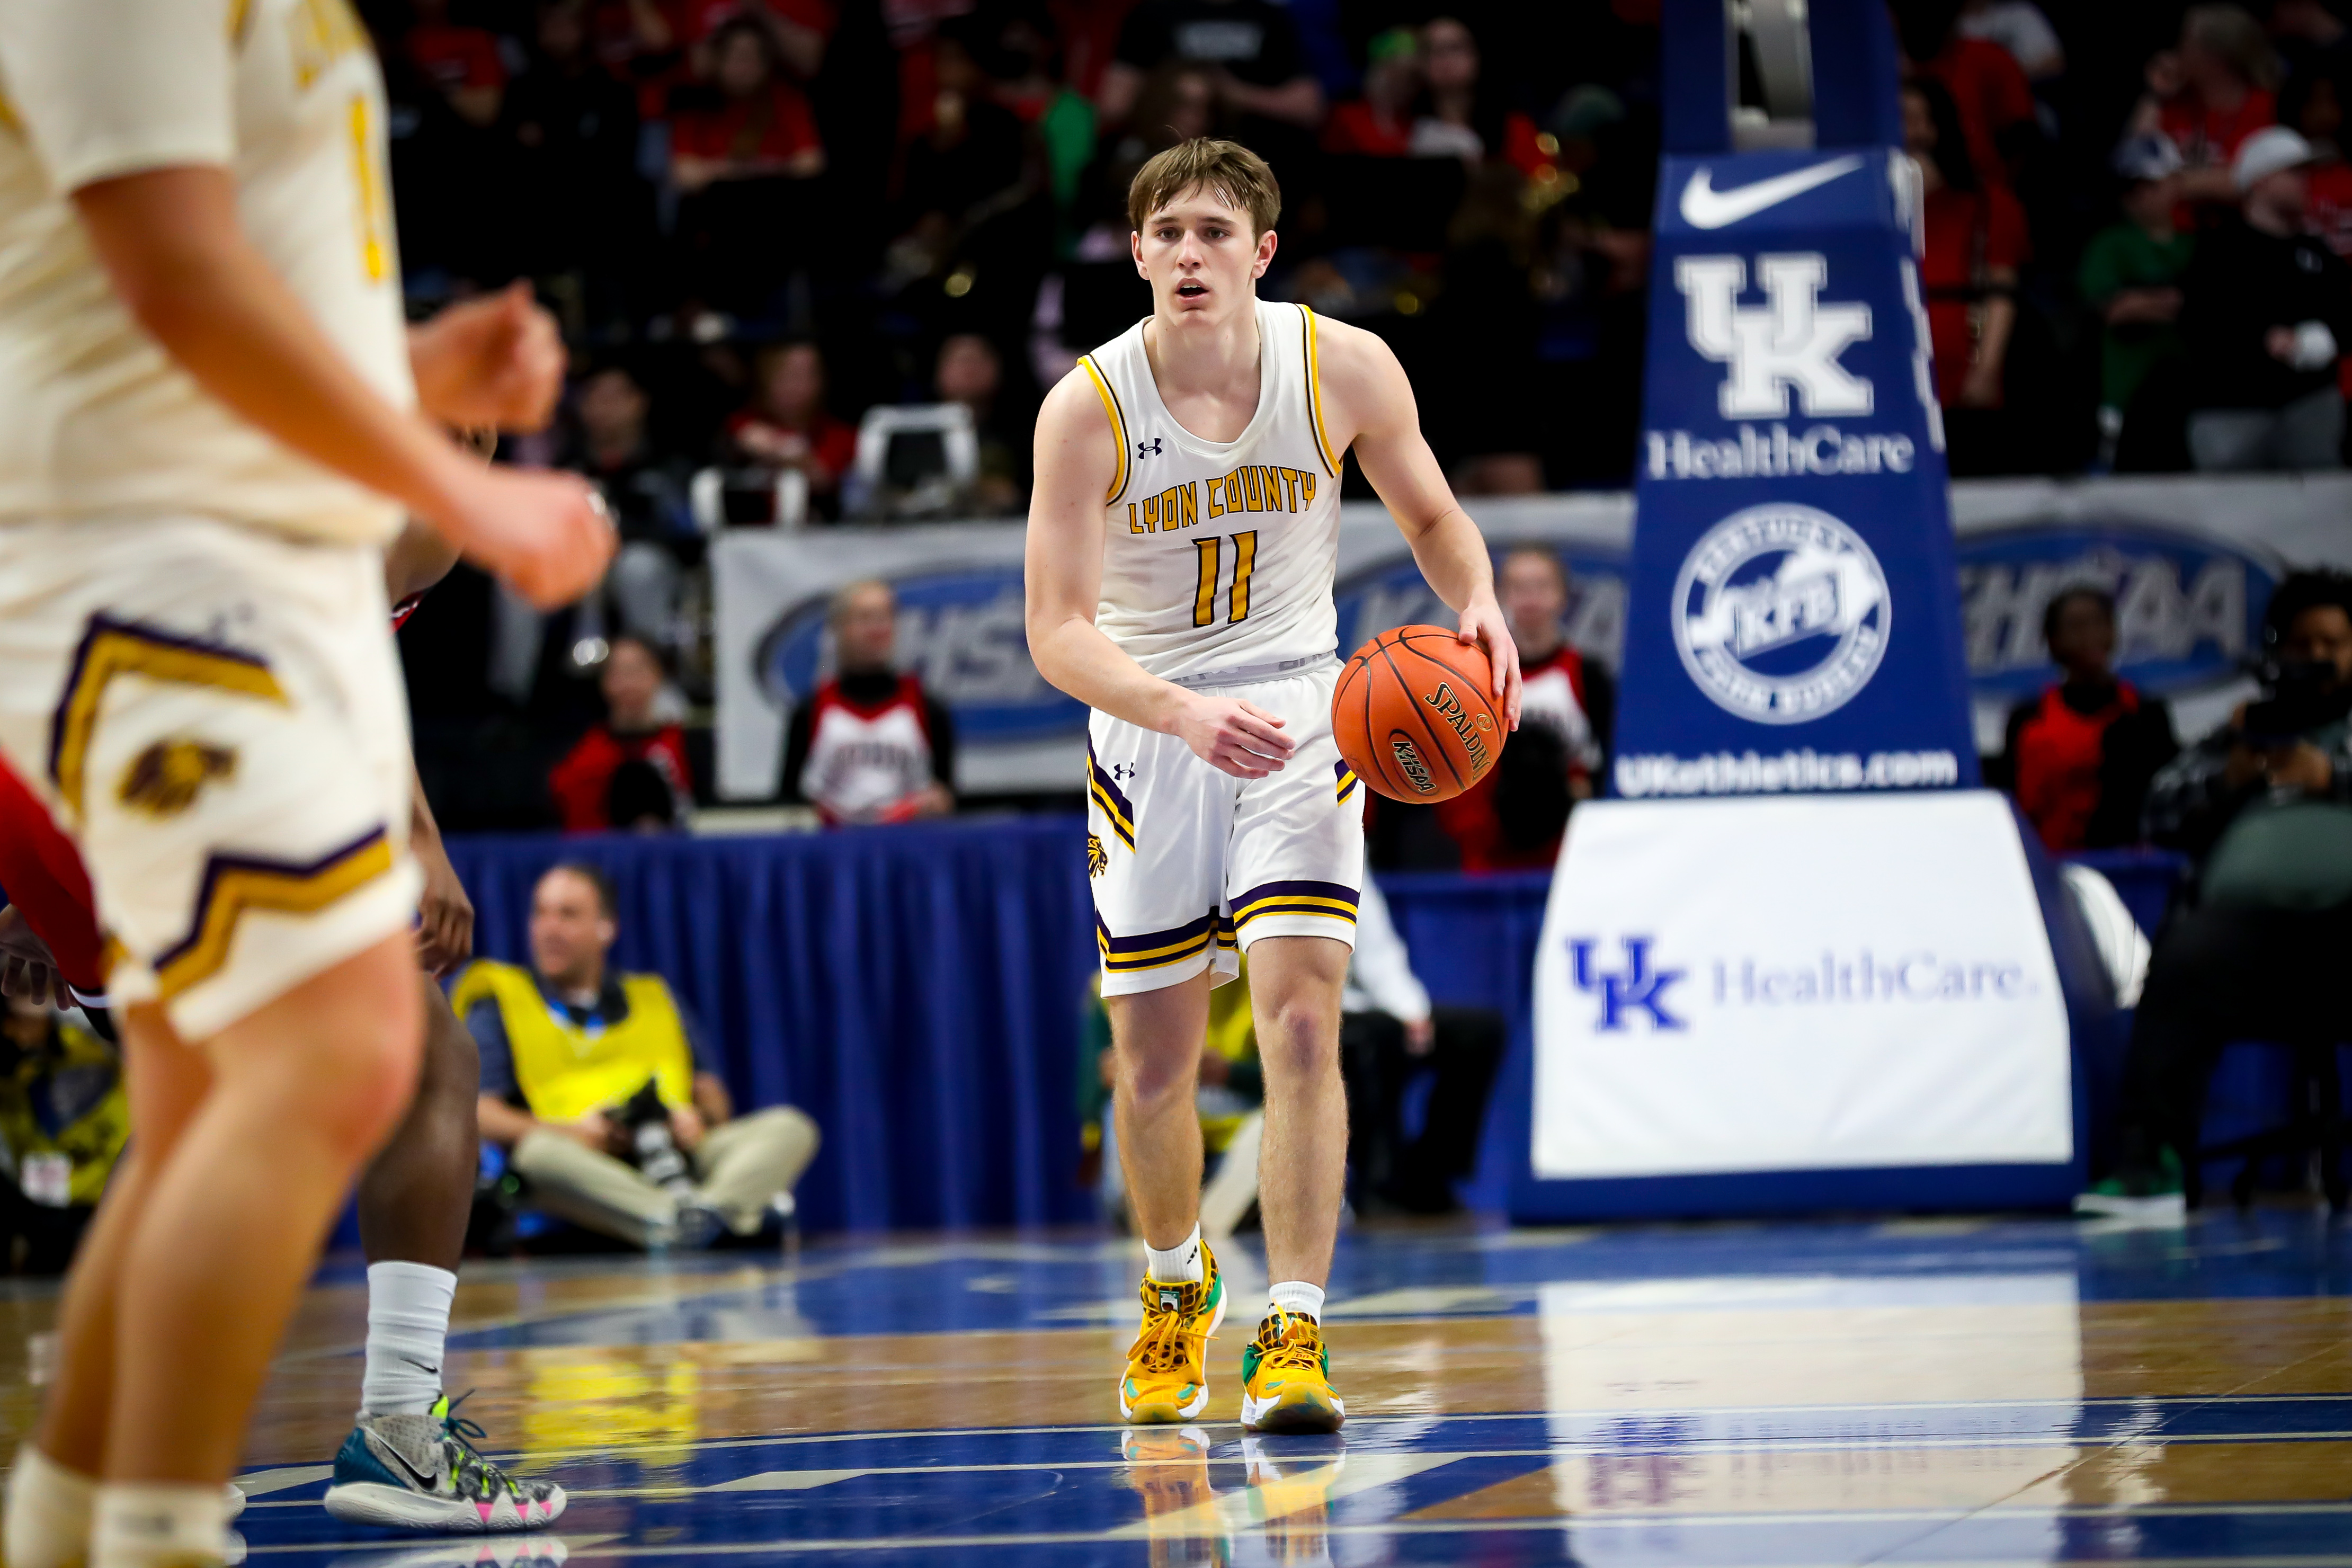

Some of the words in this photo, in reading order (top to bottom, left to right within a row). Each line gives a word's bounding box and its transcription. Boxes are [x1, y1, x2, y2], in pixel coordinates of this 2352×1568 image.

[1674, 252, 1874, 420] UK
[1646, 425, 1915, 479] HealthCare
[1128, 481, 1198, 534] LYON
[1205, 465, 1316, 519] COUNTY
[1191, 529, 1258, 627] 11
[1742, 583, 1838, 649] KFB
[1392, 741, 1437, 792] KHSAA
[1614, 748, 1958, 796] UKathletics.com
[1564, 936, 1690, 1036] UK
